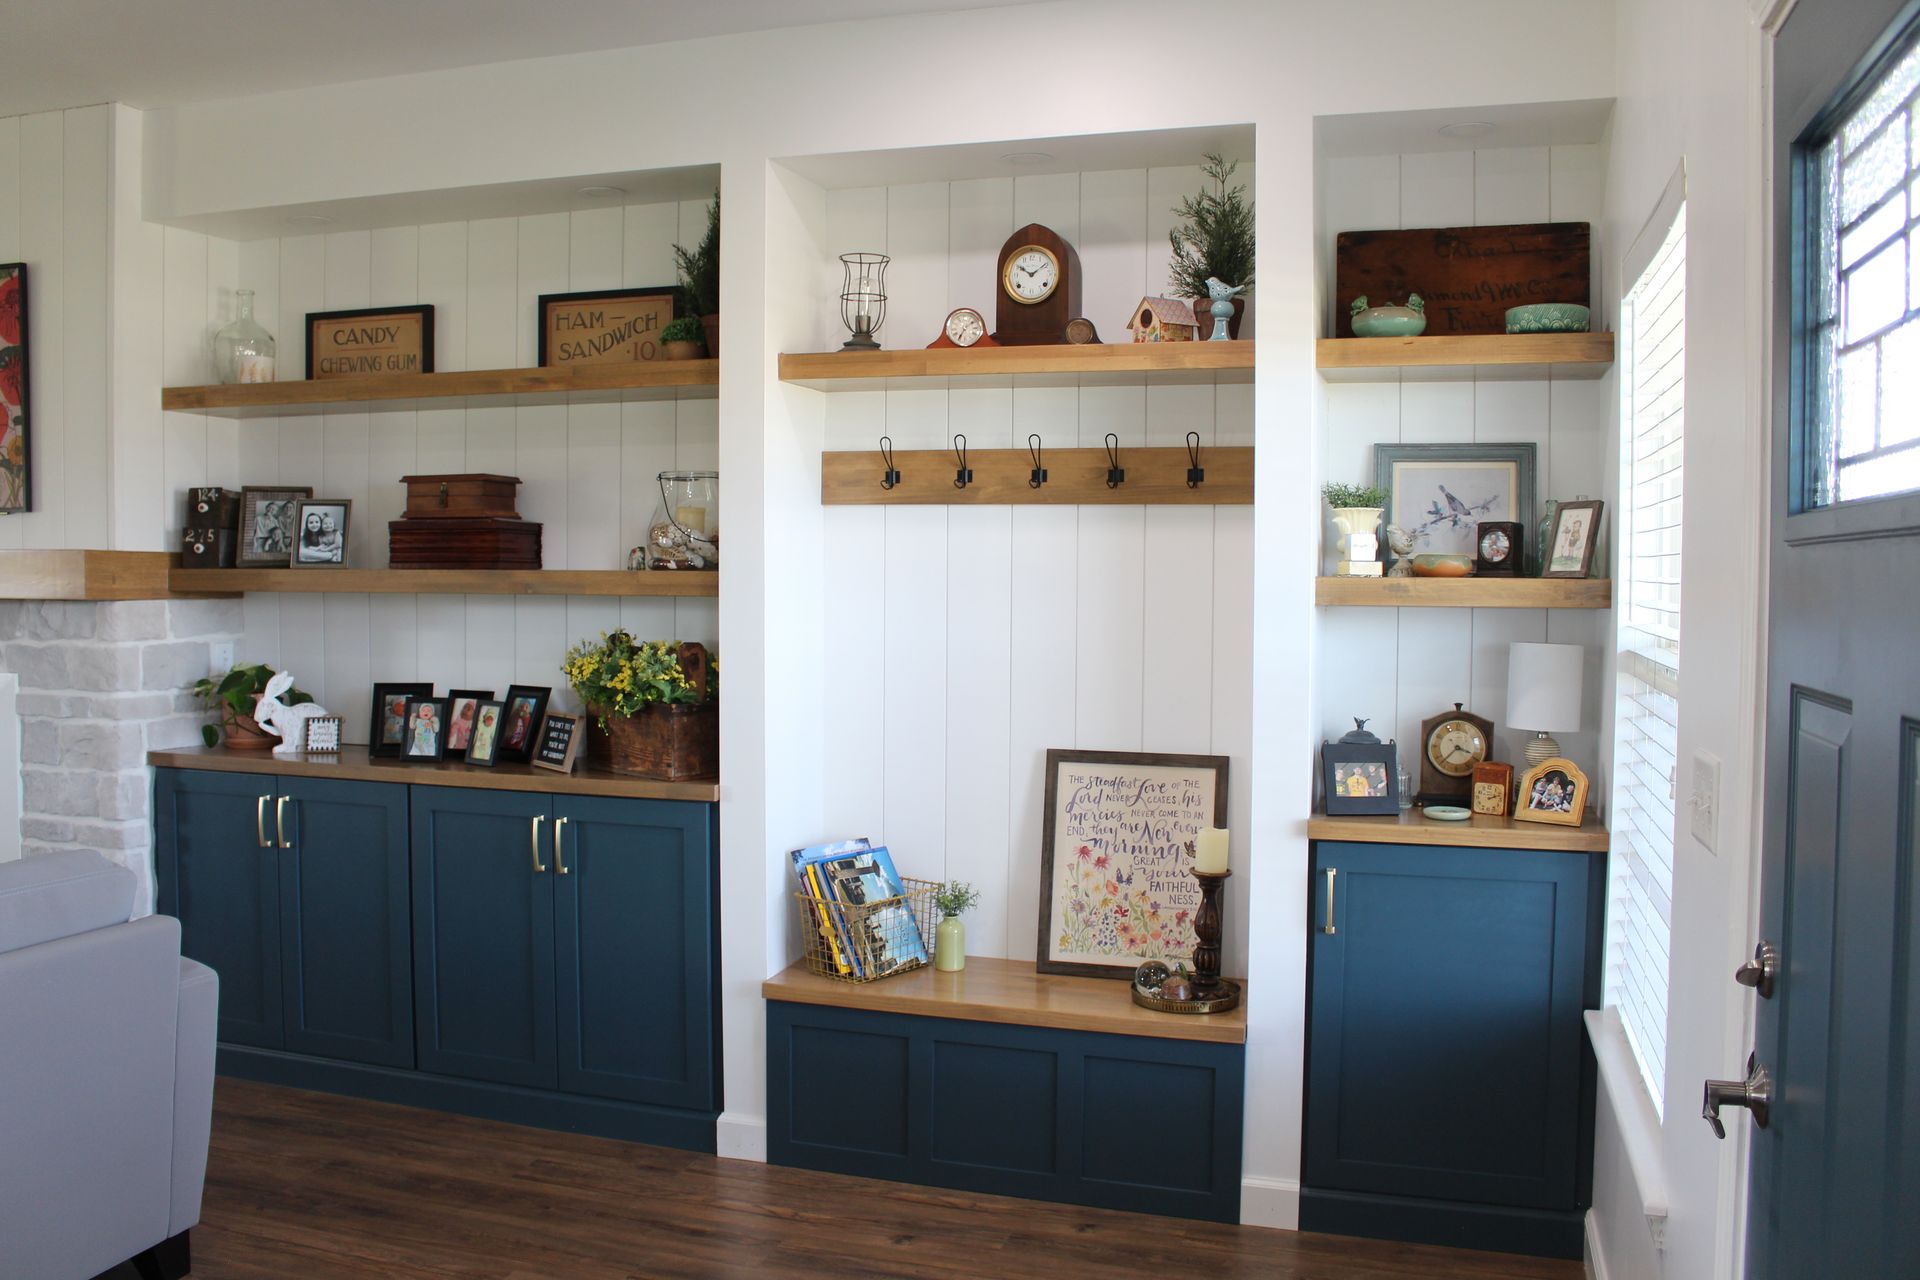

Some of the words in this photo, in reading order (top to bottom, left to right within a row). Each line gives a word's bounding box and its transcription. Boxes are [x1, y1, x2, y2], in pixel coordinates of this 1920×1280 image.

[555, 311, 605, 331] HAM
[333, 326, 401, 346] CANDY
[558, 311, 659, 361] SANDWICH
[320, 355, 382, 374] CHEWING
[387, 353, 417, 371] GUM
[1069, 775, 1084, 784] THE
[1183, 780, 1200, 789] THE
[1106, 794, 1131, 802] NEVER
[1070, 809, 1125, 825] mercies
[1131, 809, 1155, 819] NEVER
[1158, 809, 1179, 818] COME
[1183, 811, 1192, 819] TO
[1193, 811, 1204, 819] AN
[1089, 822, 1117, 846] they
[1120, 822, 1140, 834] are
[1133, 856, 1160, 866] GREAT
[1182, 857, 1190, 866] IS
[1134, 867, 1190, 881] your
[1150, 881, 1200, 894] FAITHFUL
